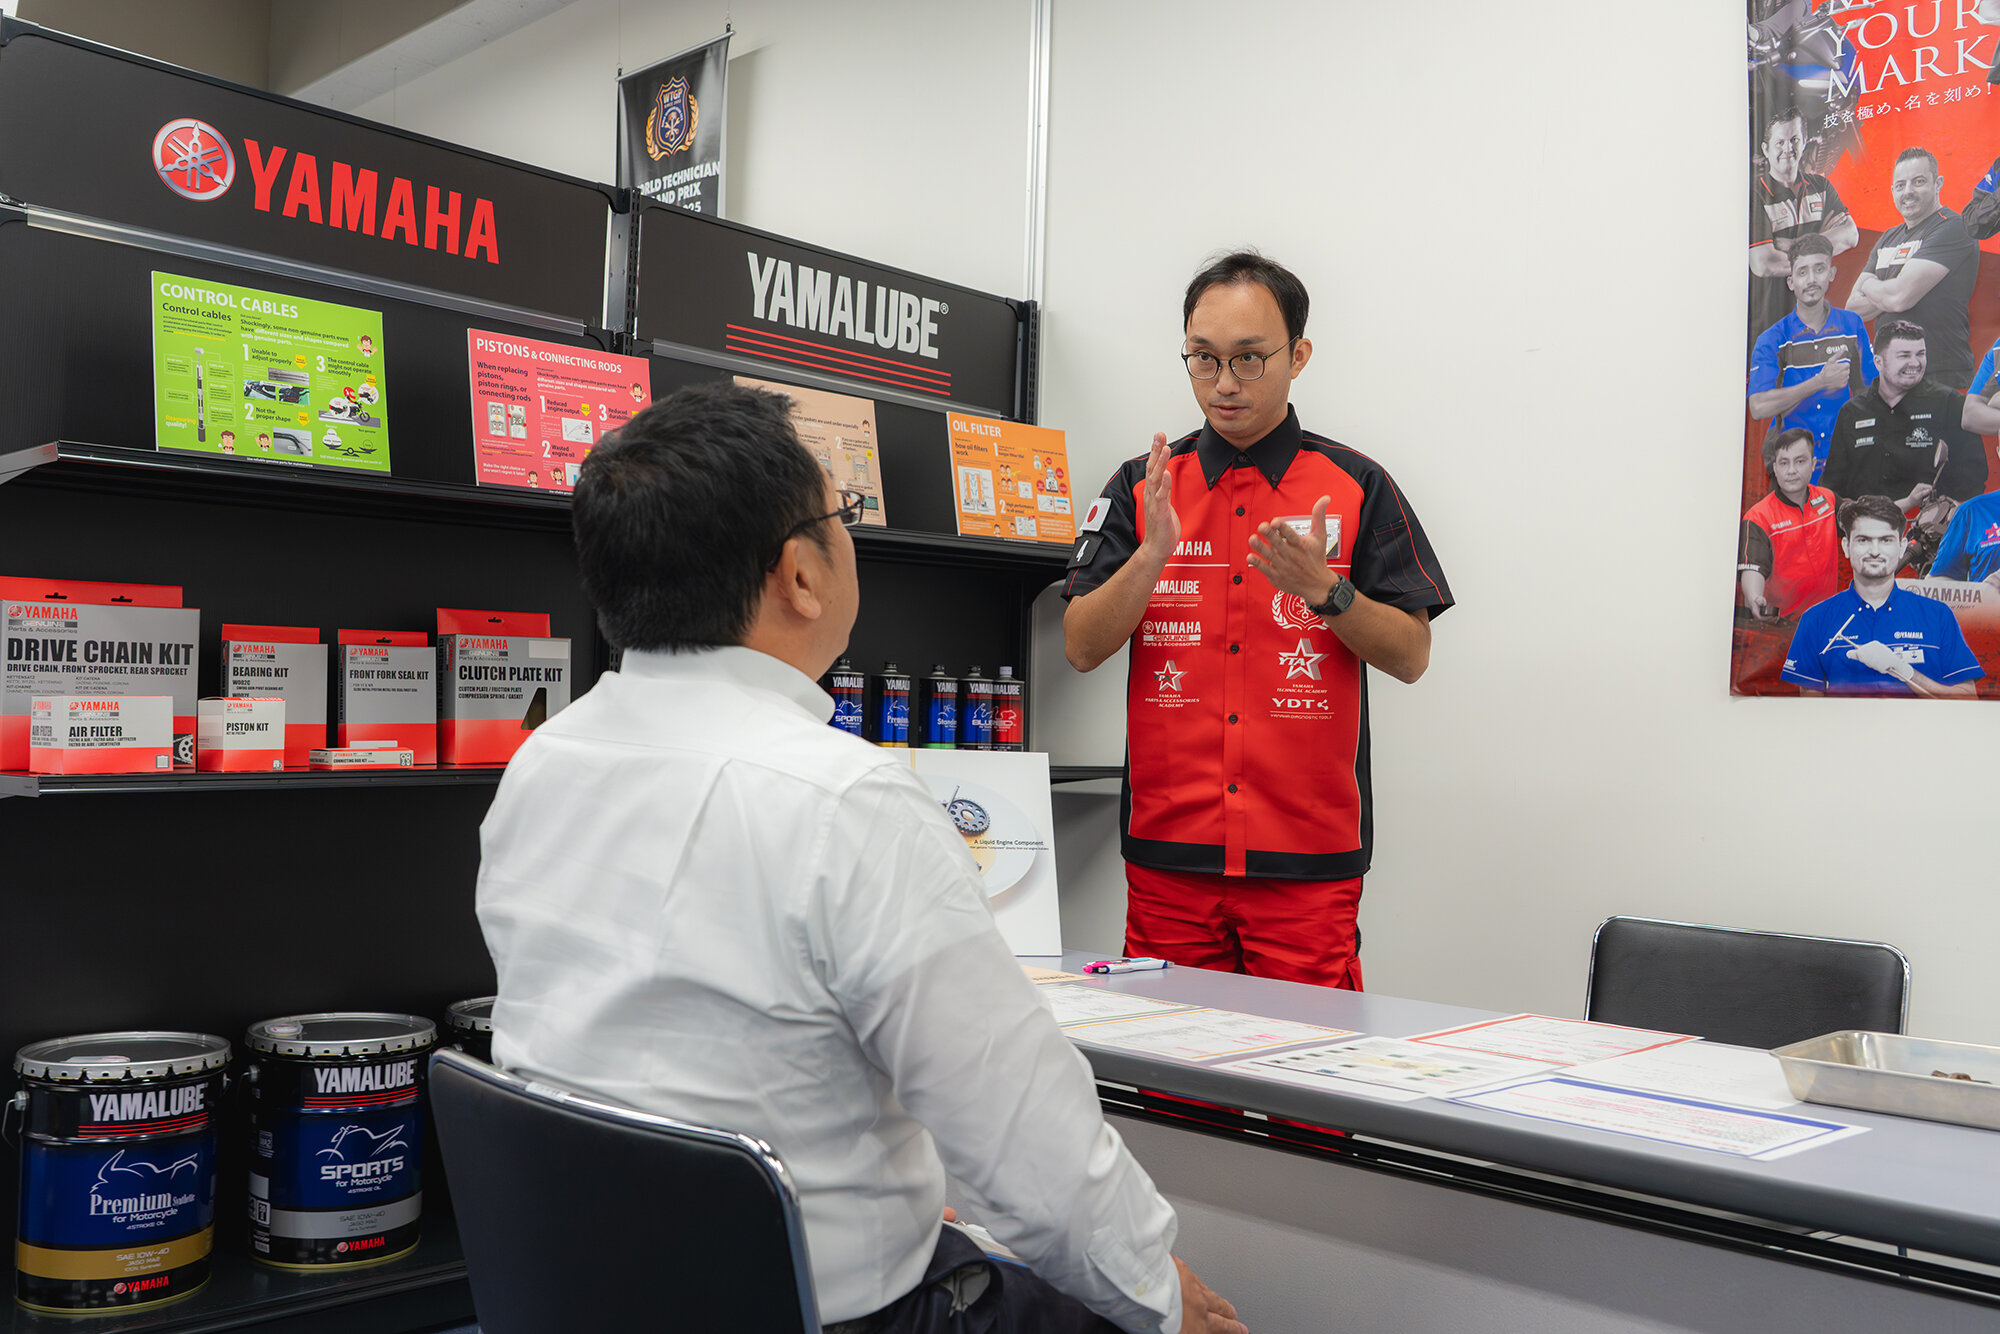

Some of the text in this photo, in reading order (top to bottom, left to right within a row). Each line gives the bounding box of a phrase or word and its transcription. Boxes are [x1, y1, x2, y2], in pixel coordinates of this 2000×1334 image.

[1824, 0, 1990, 59] YOUR
[1825, 34, 1996, 103] MARK
[663, 88, 683, 104] WTGP
[662, 161, 721, 188] TECHNICIAN
[678, 181, 701, 201] PRIX
[243, 138, 500, 264] YAMAHA
[160, 283, 299, 318] CONTROL CABLES
[162, 302, 232, 321] Control cables
[242, 343, 249, 361] 1
[251, 347, 271, 357] Unable
[476, 338, 622, 374] PISTONS & CONNECTING RODS
[251, 354, 293, 366] adjust properly
[316, 355, 326, 372] 3
[337, 358, 355, 367] control
[327, 362, 341, 371] might
[352, 366, 372, 375] operate
[328, 368, 351, 377] smoothly
[476, 361, 529, 377] When replacing
[477, 372, 504, 382] pistons,
[478, 380, 499, 391] piston
[500, 383, 519, 393] rings,
[478, 389, 531, 402] connecting rods
[539, 395, 546, 413] 1
[547, 399, 568, 408] Reduced
[244, 402, 254, 420] 2
[256, 413, 291, 423] proper shape
[547, 406, 580, 416] engine output
[598, 404, 607, 421] 3
[608, 407, 628, 416] Reduced
[952, 420, 1002, 437] OIL FILTER
[541, 440, 551, 458] 2
[551, 444, 570, 452] Wasted
[551, 450, 568, 459] engine
[955, 442, 966, 450] how
[974, 444, 988, 453] filters
[956, 449, 968, 457] work
[993, 442, 999, 457] 1
[1000, 499, 1007, 514] 2
[1172, 541, 1212, 556] MAHA
[1153, 580, 1200, 594] AMALUBE
[1923, 586, 1982, 603] YAMAHA
[24, 605, 78, 620] YAMAHA
[1154, 621, 1202, 634] YAMAHA
[1900, 631, 1924, 640] YAMAHA
[243, 644, 275, 654] YAMAHA
[470, 638, 508, 650] YAMAHA
[7, 638, 194, 666] DRIVE CHAIN KIT
[358, 648, 389, 657] YAMAHA
[1279, 657, 1306, 666] YTA
[7, 663, 188, 676] DRIVE CHAIN, FRONT SPROCKET, REAR SPROCKET
[233, 667, 289, 678] BEARING KIT
[349, 670, 429, 680] FRONT FORK SEAL KIT
[459, 665, 563, 682] CLUTCH PLATE KIT
[80, 701, 119, 711] YAMAHA
[1271, 697, 1315, 709] YDT
[69, 726, 123, 737] AIR FILTER
[226, 723, 269, 732] PISTON KIT
[320, 1155, 404, 1180] SPORTS
[350, 1174, 393, 1186] Motorcycle
[90, 1192, 172, 1216] Premium
[112, 1207, 178, 1223] for Motorcycle
[348, 1236, 385, 1251] YAMAHA
[116, 1247, 170, 1261] SAE 10W-40
[127, 1276, 169, 1293] YAMAHA
